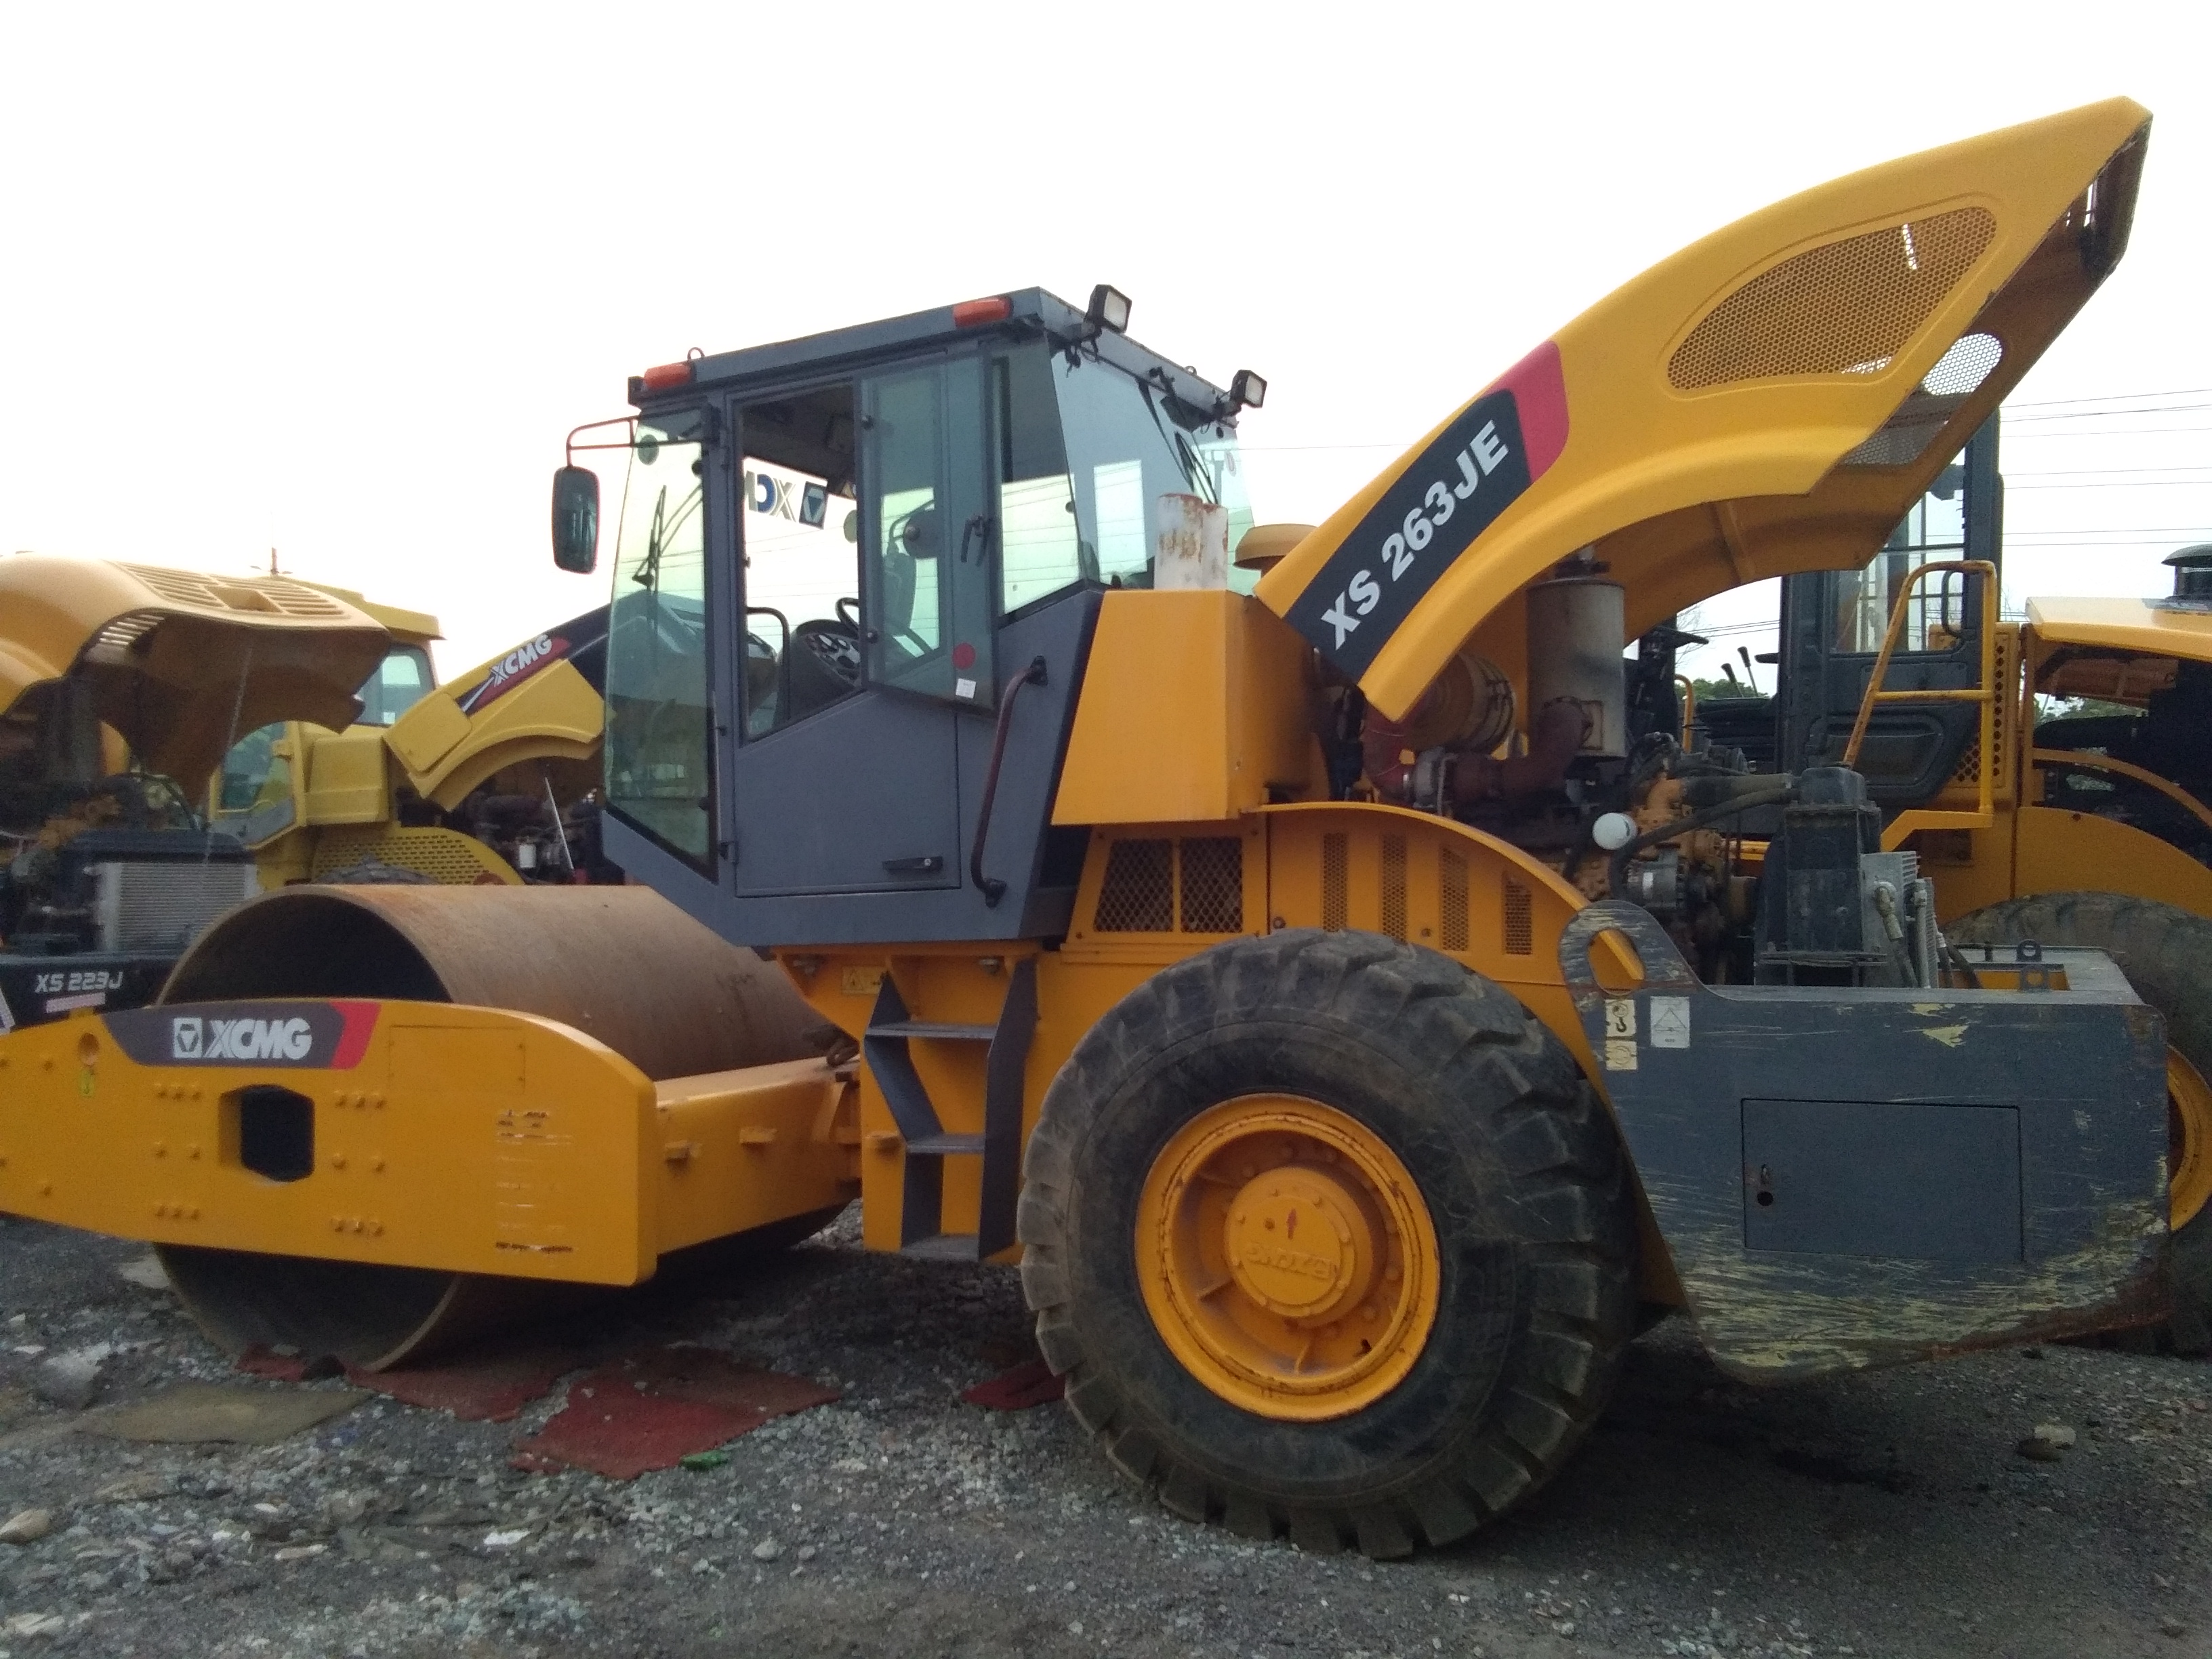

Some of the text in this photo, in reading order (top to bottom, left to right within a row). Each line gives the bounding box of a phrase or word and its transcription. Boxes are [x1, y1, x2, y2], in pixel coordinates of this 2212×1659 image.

[1321, 419, 1509, 651] XS 263JE
[490, 634, 552, 687] XCMG
[35, 971, 123, 992] XS 223J
[204, 1018, 312, 1059] XCMG
